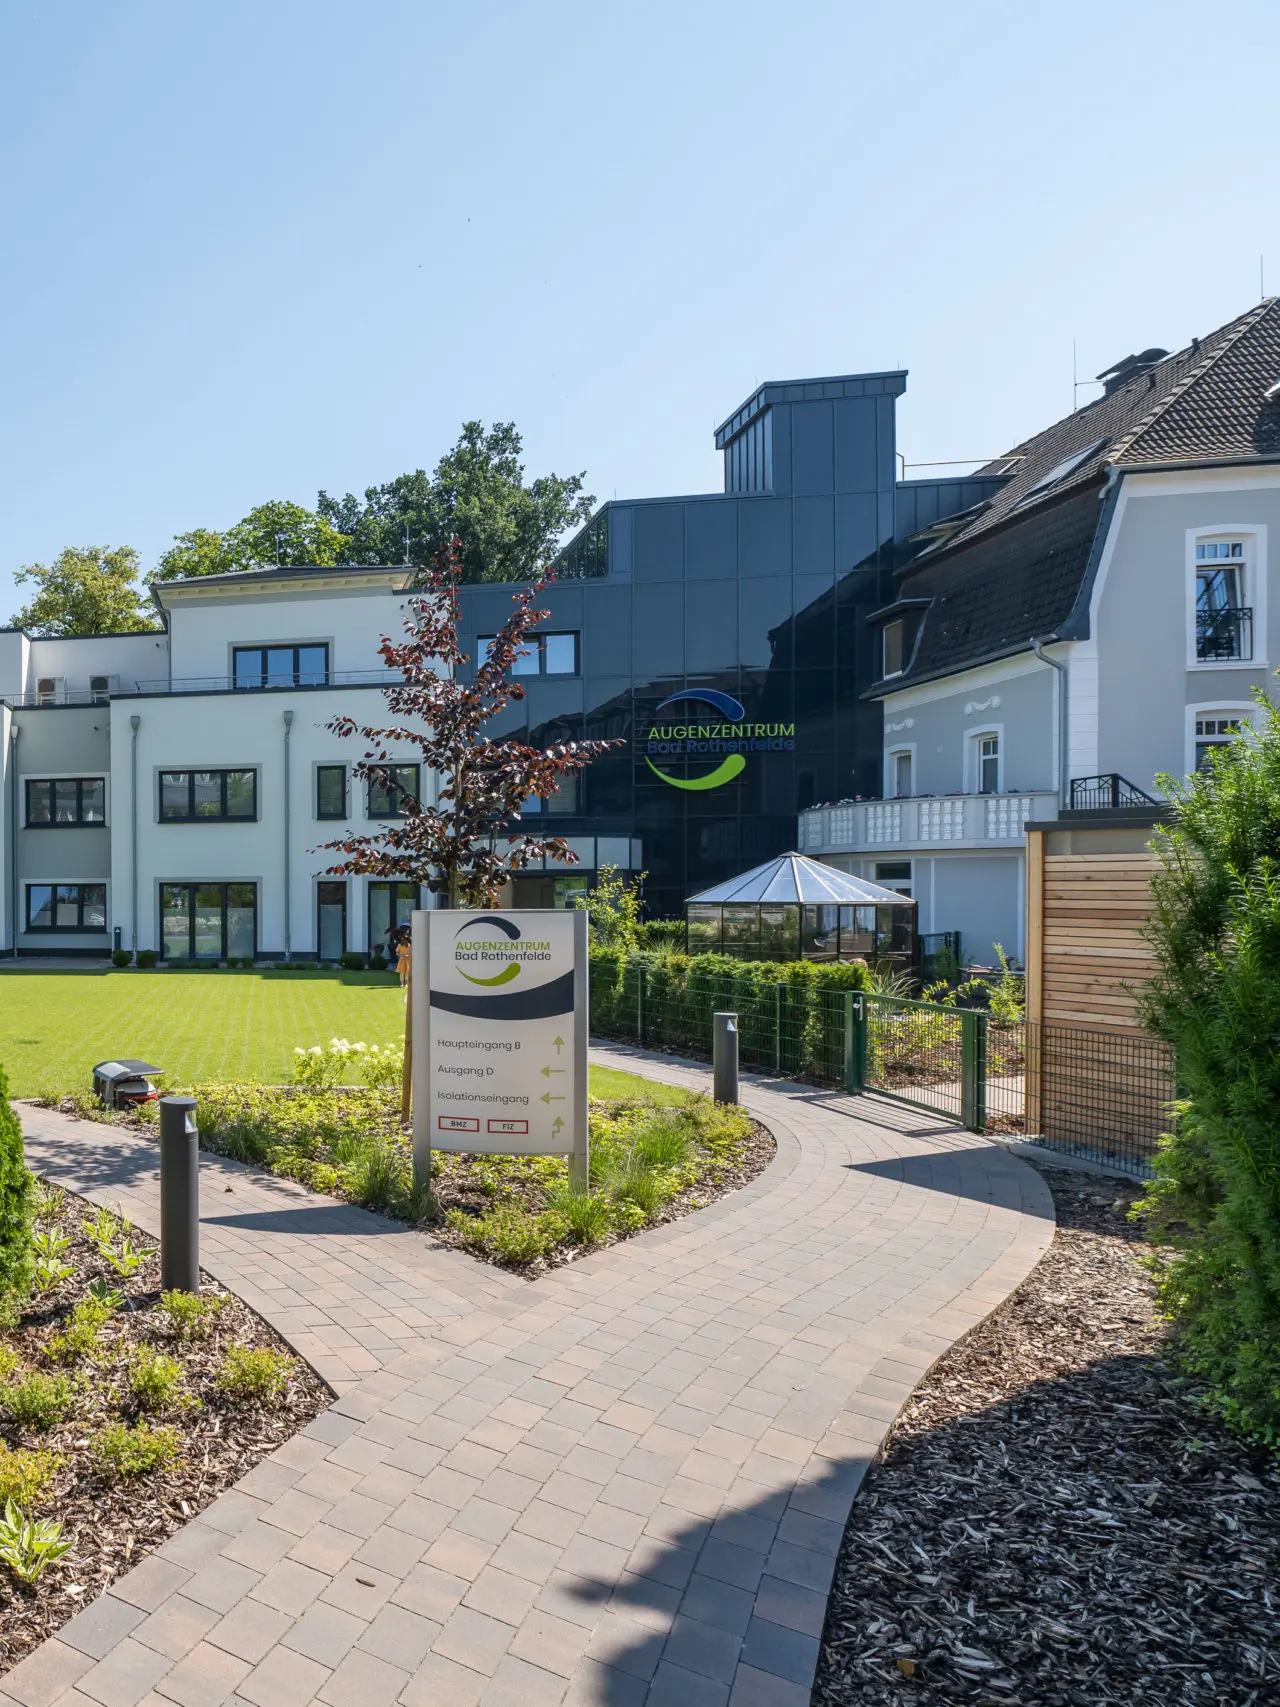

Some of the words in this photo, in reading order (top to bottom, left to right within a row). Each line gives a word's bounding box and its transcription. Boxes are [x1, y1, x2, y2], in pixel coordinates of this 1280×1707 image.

[648, 723, 795, 740] AUGENZENTRUM
[647, 740, 682, 754] Bad
[686, 737, 796, 753] Rothenfelde
[456, 941, 551, 951] AUGENZENTRUM
[454, 951, 479, 961] Bad
[481, 951, 552, 961] Rothenfelde
[437, 1039, 512, 1052] Haupteingang
[514, 1041, 521, 1050] B
[437, 1065, 484, 1077] Ausgang
[486, 1067, 494, 1076] D
[437, 1091, 529, 1105] Isolationseingang
[450, 1120, 467, 1128] BMZ
[502, 1123, 514, 1131] FIZ
